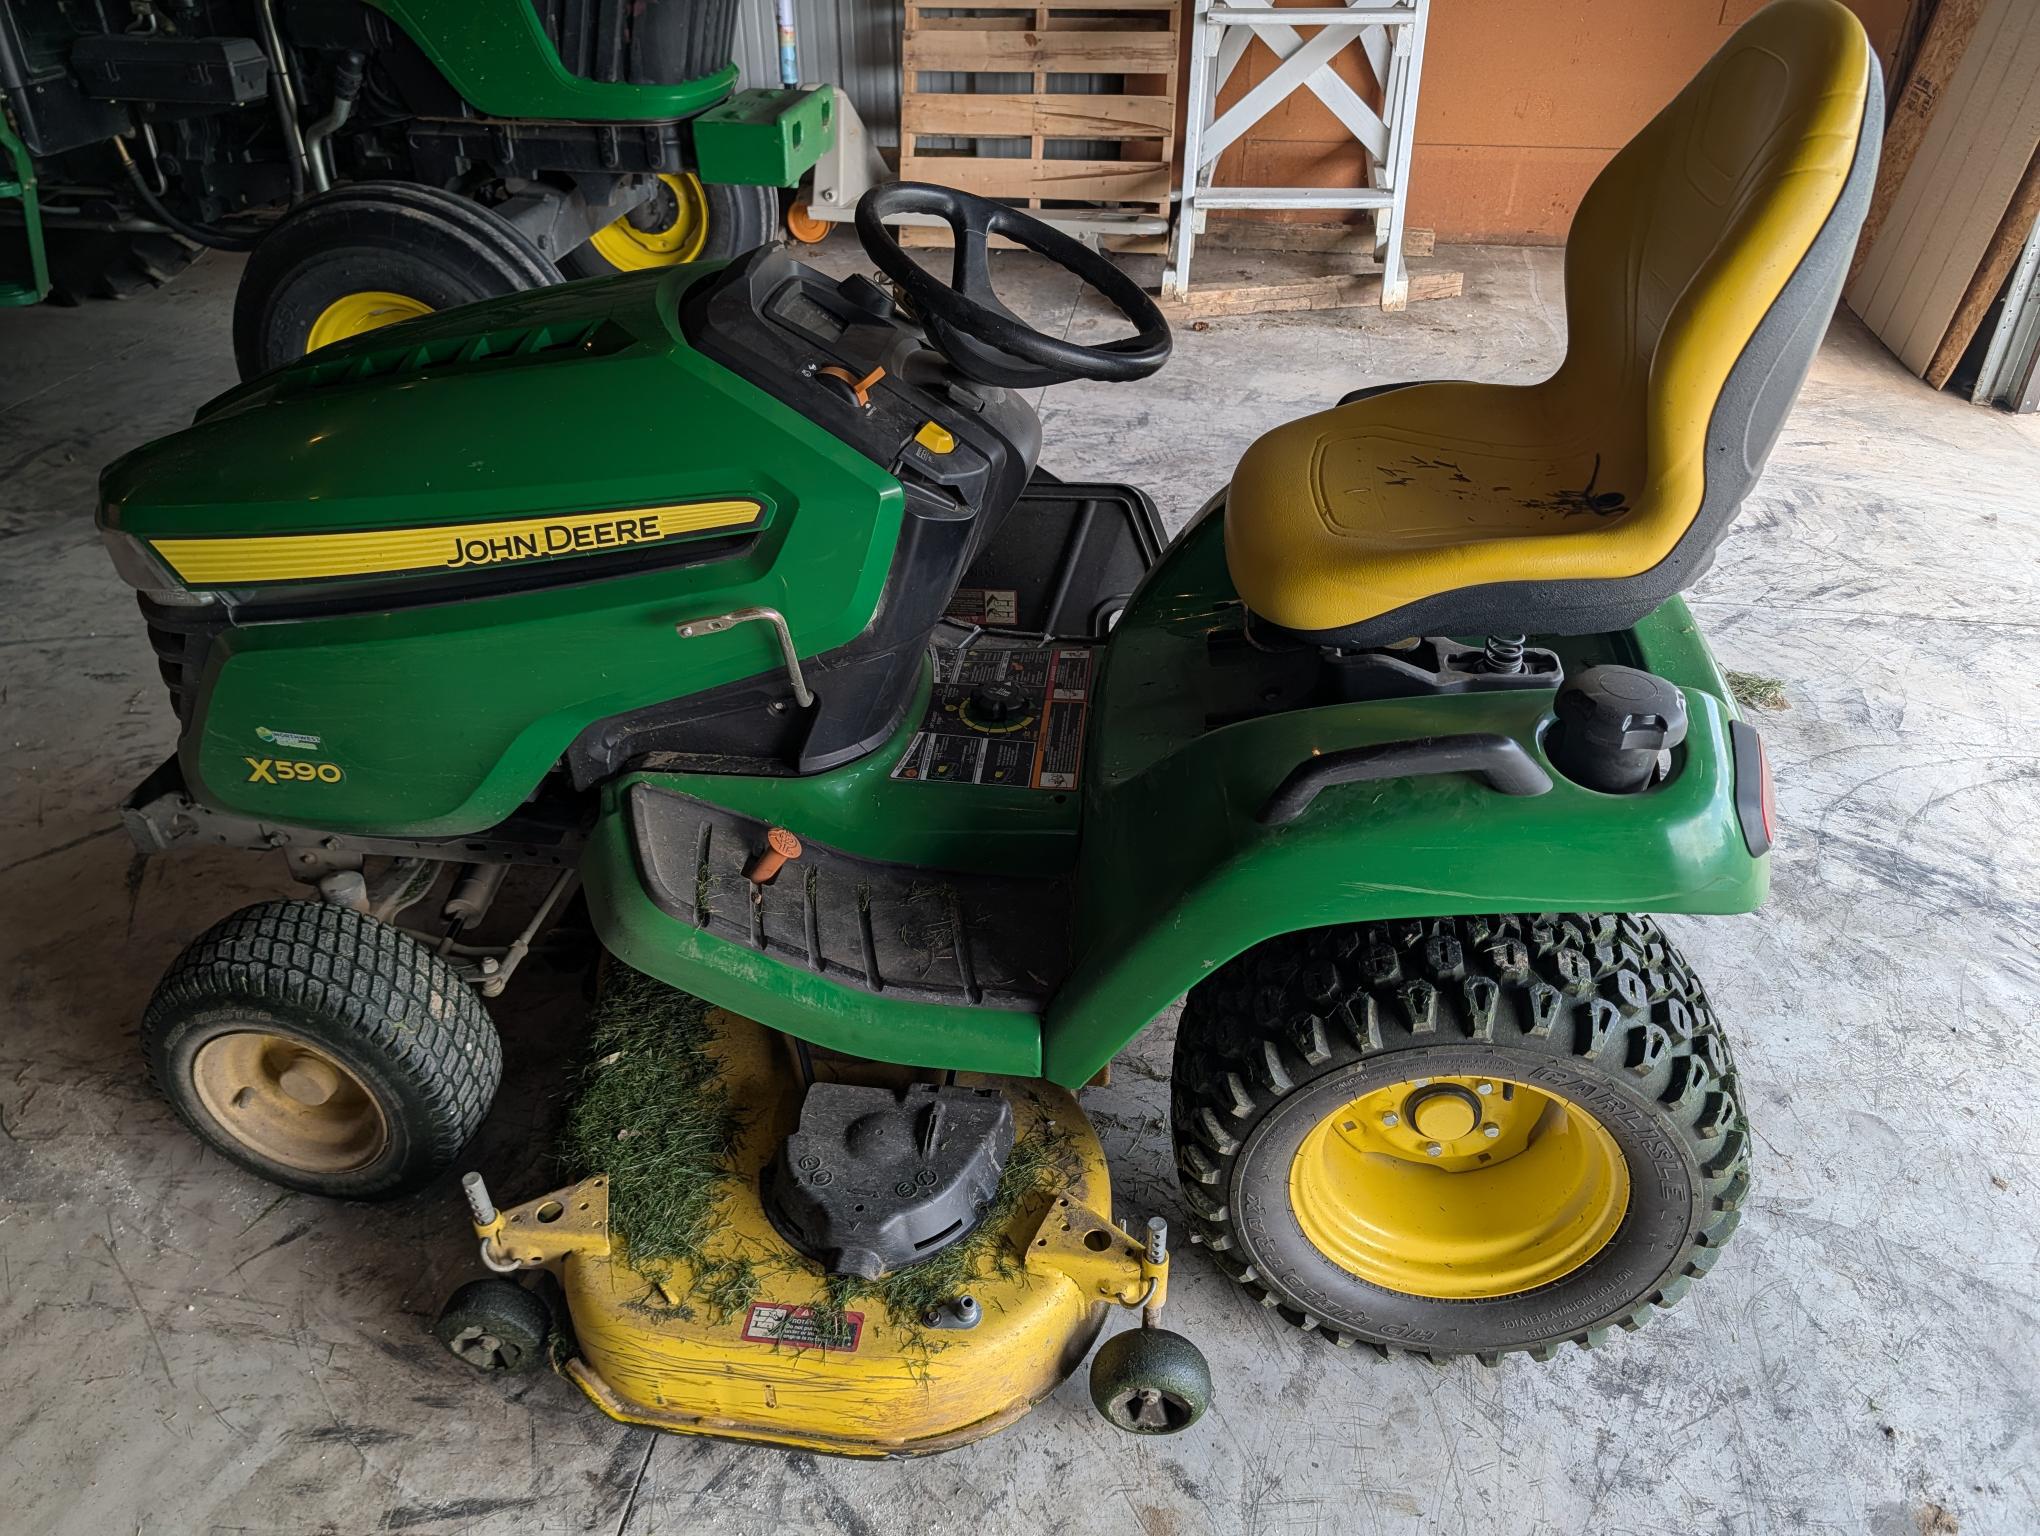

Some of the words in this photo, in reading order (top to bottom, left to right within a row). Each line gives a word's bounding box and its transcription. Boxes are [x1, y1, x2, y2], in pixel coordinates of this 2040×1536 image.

[447, 532, 538, 565] JOHN
[544, 515, 661, 551] DEERE
[244, 757, 342, 784] X590
[1332, 1072, 1369, 1092] DANGER
[1528, 1066, 1688, 1204] CARLISLE
[1245, 1192, 1284, 1268] TRAX
[1594, 1281, 1614, 1299] FOR
[1612, 1266, 1634, 1288] NOT
[1282, 1268, 1373, 1327] FIELD
[1549, 1293, 1594, 1320] HIGHWAY
[1499, 1312, 1548, 1330] SERVICE
[1525, 1322, 1559, 1339] NHS
